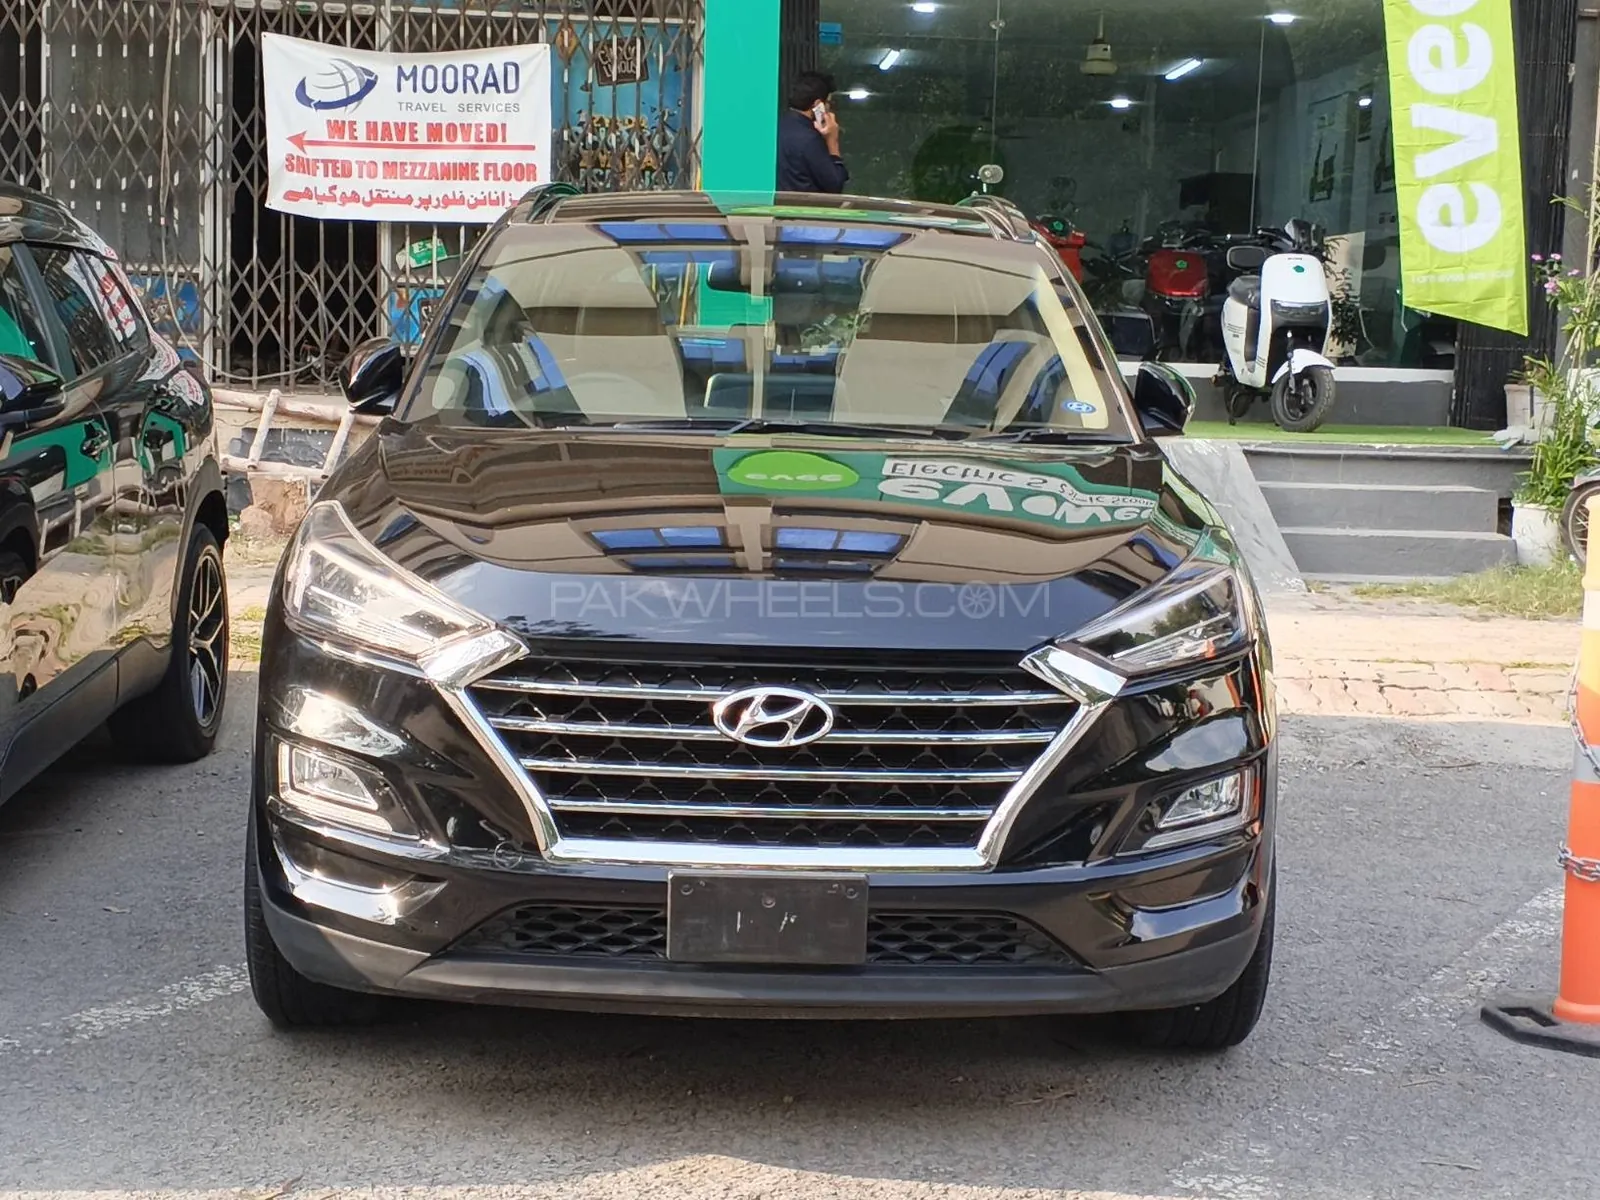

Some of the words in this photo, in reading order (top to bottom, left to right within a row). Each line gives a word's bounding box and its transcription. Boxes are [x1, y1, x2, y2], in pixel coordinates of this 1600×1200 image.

[396, 61, 521, 94] MOORAD
[398, 101, 447, 113] TRAVEL
[457, 102, 520, 113] SERVICES
[326, 119, 358, 141] WE
[366, 120, 419, 142] HAVE
[426, 122, 507, 143] MOVED!
[1407, 0, 1502, 254] eve
[285, 152, 352, 179] SHIFTED
[355, 159, 379, 180] TO
[382, 160, 479, 182] MEZZANINE
[483, 162, 537, 182] FLOOR
